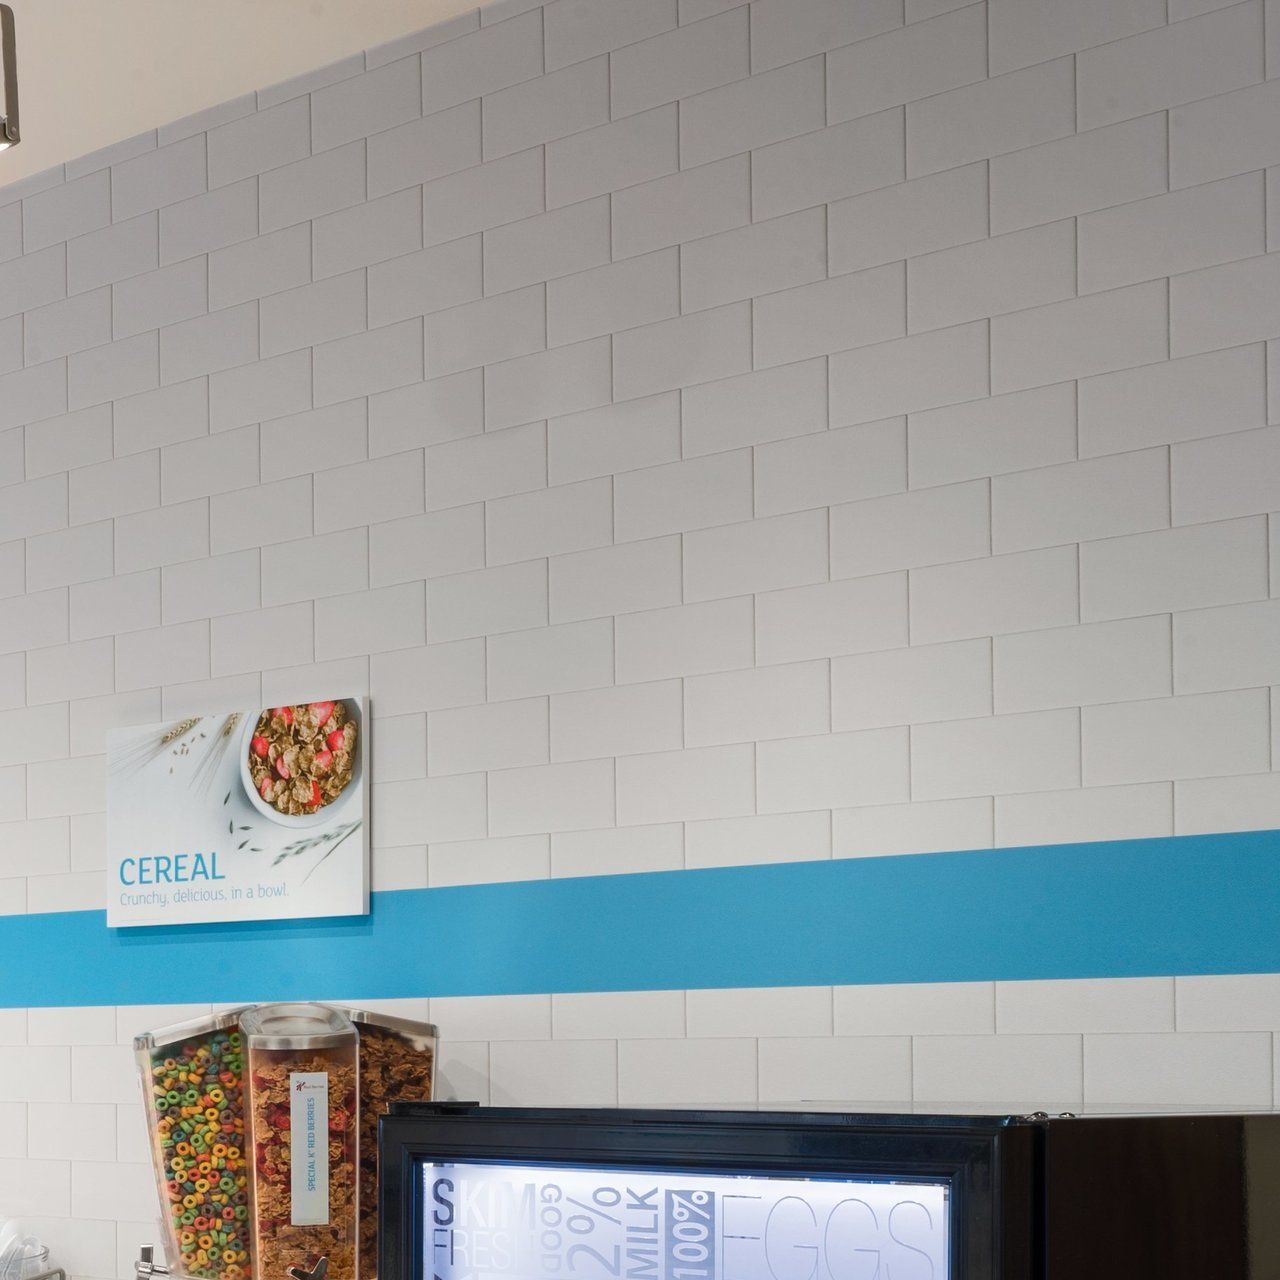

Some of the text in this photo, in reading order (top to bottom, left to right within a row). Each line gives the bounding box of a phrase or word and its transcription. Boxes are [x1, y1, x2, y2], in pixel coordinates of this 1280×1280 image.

[119, 852, 226, 886] CEREAL
[120, 882, 289, 908] Crunchy, delicious, in a bowl.
[306, 1097, 315, 1131] BERRIES
[307, 1132, 316, 1149] RED
[307, 1160, 316, 1192] SPECIAL
[540, 1183, 562, 1273] GOOD
[566, 1186, 622, 1277] 2%
[626, 1186, 659, 1280] MILK
[672, 1190, 709, 1280] 100%
